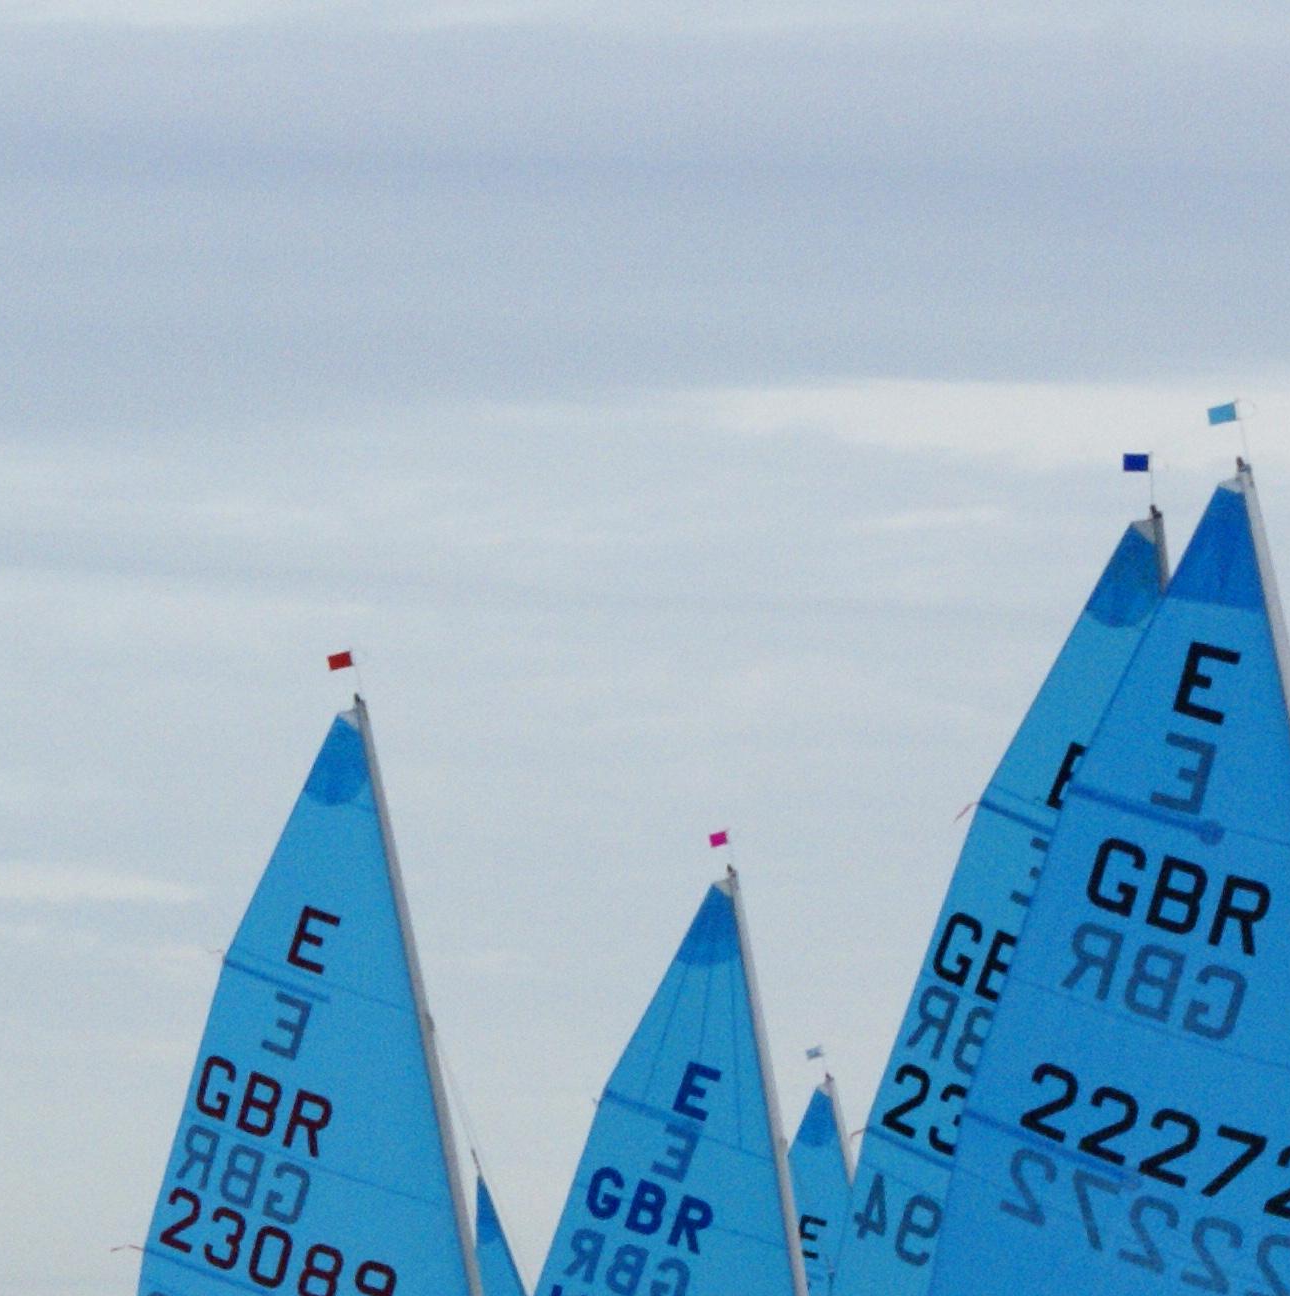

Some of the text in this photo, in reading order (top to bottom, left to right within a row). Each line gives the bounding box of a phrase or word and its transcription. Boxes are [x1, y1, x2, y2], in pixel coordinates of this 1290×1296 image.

[1173, 641, 1241, 725] E
[287, 905, 341, 975] E
[1085, 837, 1271, 956] GBR
[195, 1055, 334, 1158] GBR
[672, 1061, 722, 1122] E
[585, 1165, 714, 1255] GBR
